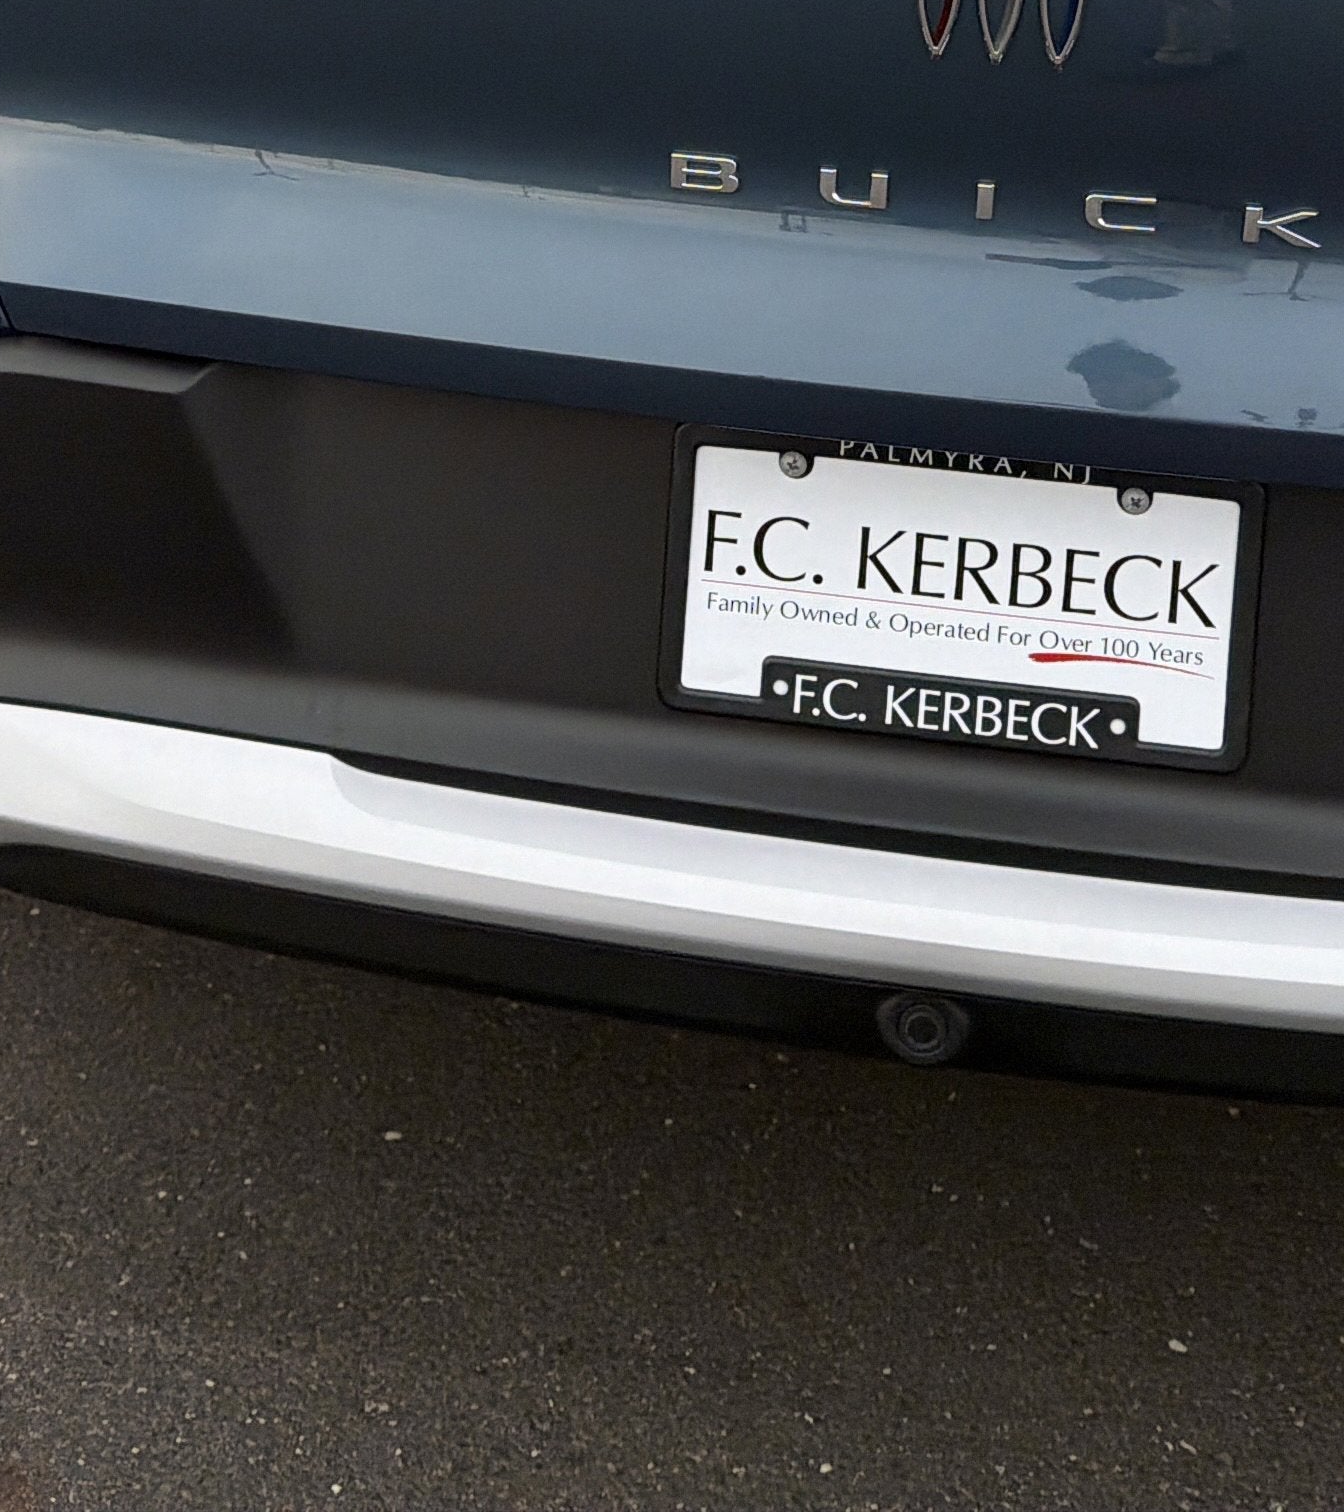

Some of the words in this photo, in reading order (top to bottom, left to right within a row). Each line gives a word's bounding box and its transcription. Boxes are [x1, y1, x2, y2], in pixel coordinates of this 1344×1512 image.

[669, 150, 1322, 249] BUICK
[1054, 462, 1091, 485] NJ
[704, 509, 823, 587] F.C.
[856, 525, 1220, 629] KERBECK
[707, 592, 774, 622] Family
[780, 599, 858, 627] Owned
[865, 608, 882, 630] &
[889, 612, 990, 643] Operated
[997, 622, 1031, 648] For
[1039, 630, 1093, 655] Over
[1100, 637, 1139, 659] 100
[1147, 642, 1204, 668] Years
[790, 674, 866, 723] F.C.
[884, 685, 1102, 749] KERBECK
